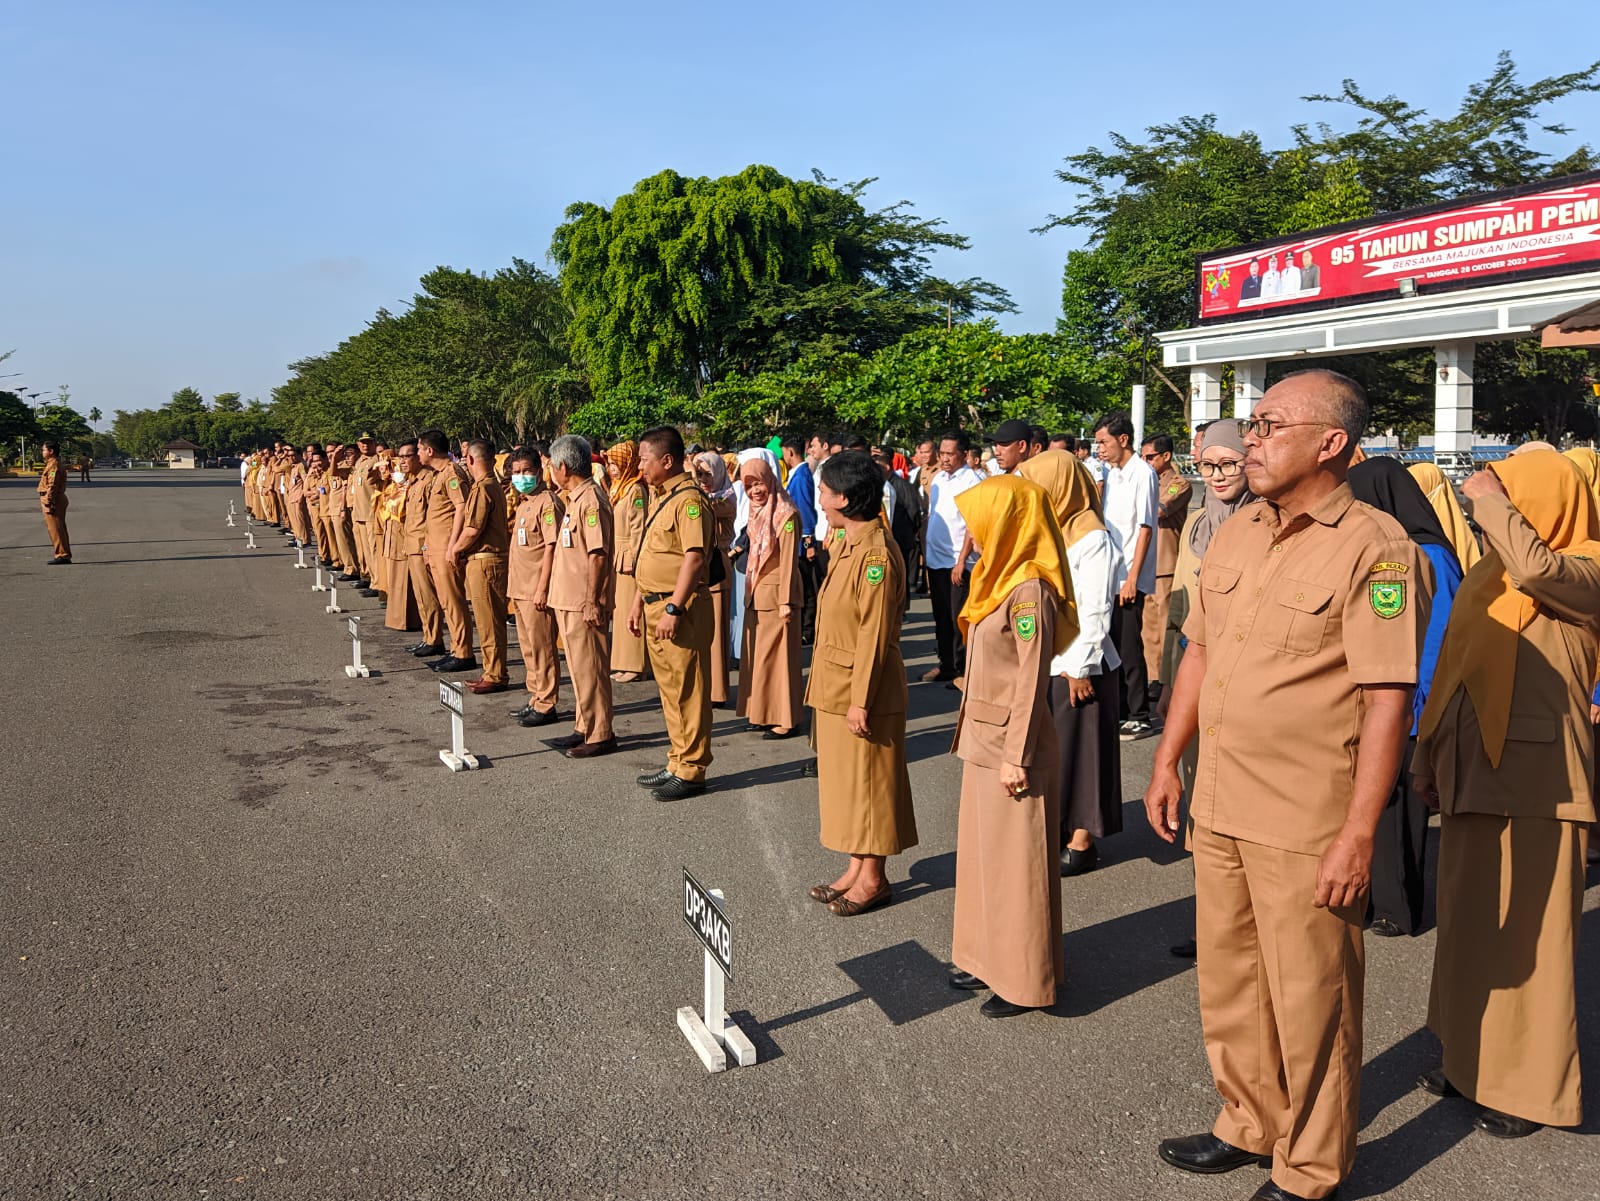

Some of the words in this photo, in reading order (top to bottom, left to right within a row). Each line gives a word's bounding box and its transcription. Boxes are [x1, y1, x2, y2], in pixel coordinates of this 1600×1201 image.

[1331, 245, 1355, 266] 95
[1360, 230, 1428, 260] TAHUN
[1434, 210, 1534, 247] SUMPAH
[1392, 254, 1443, 270] BERSAMA
[1446, 244, 1504, 261] MAJUKAN
[1507, 232, 1574, 250] INDONESIA
[1426, 267, 1459, 278] TANGGAL
[1472, 261, 1505, 272] OKTOBER
[1507, 258, 1527, 266] 2023
[685, 880, 730, 965] DP3AKB
